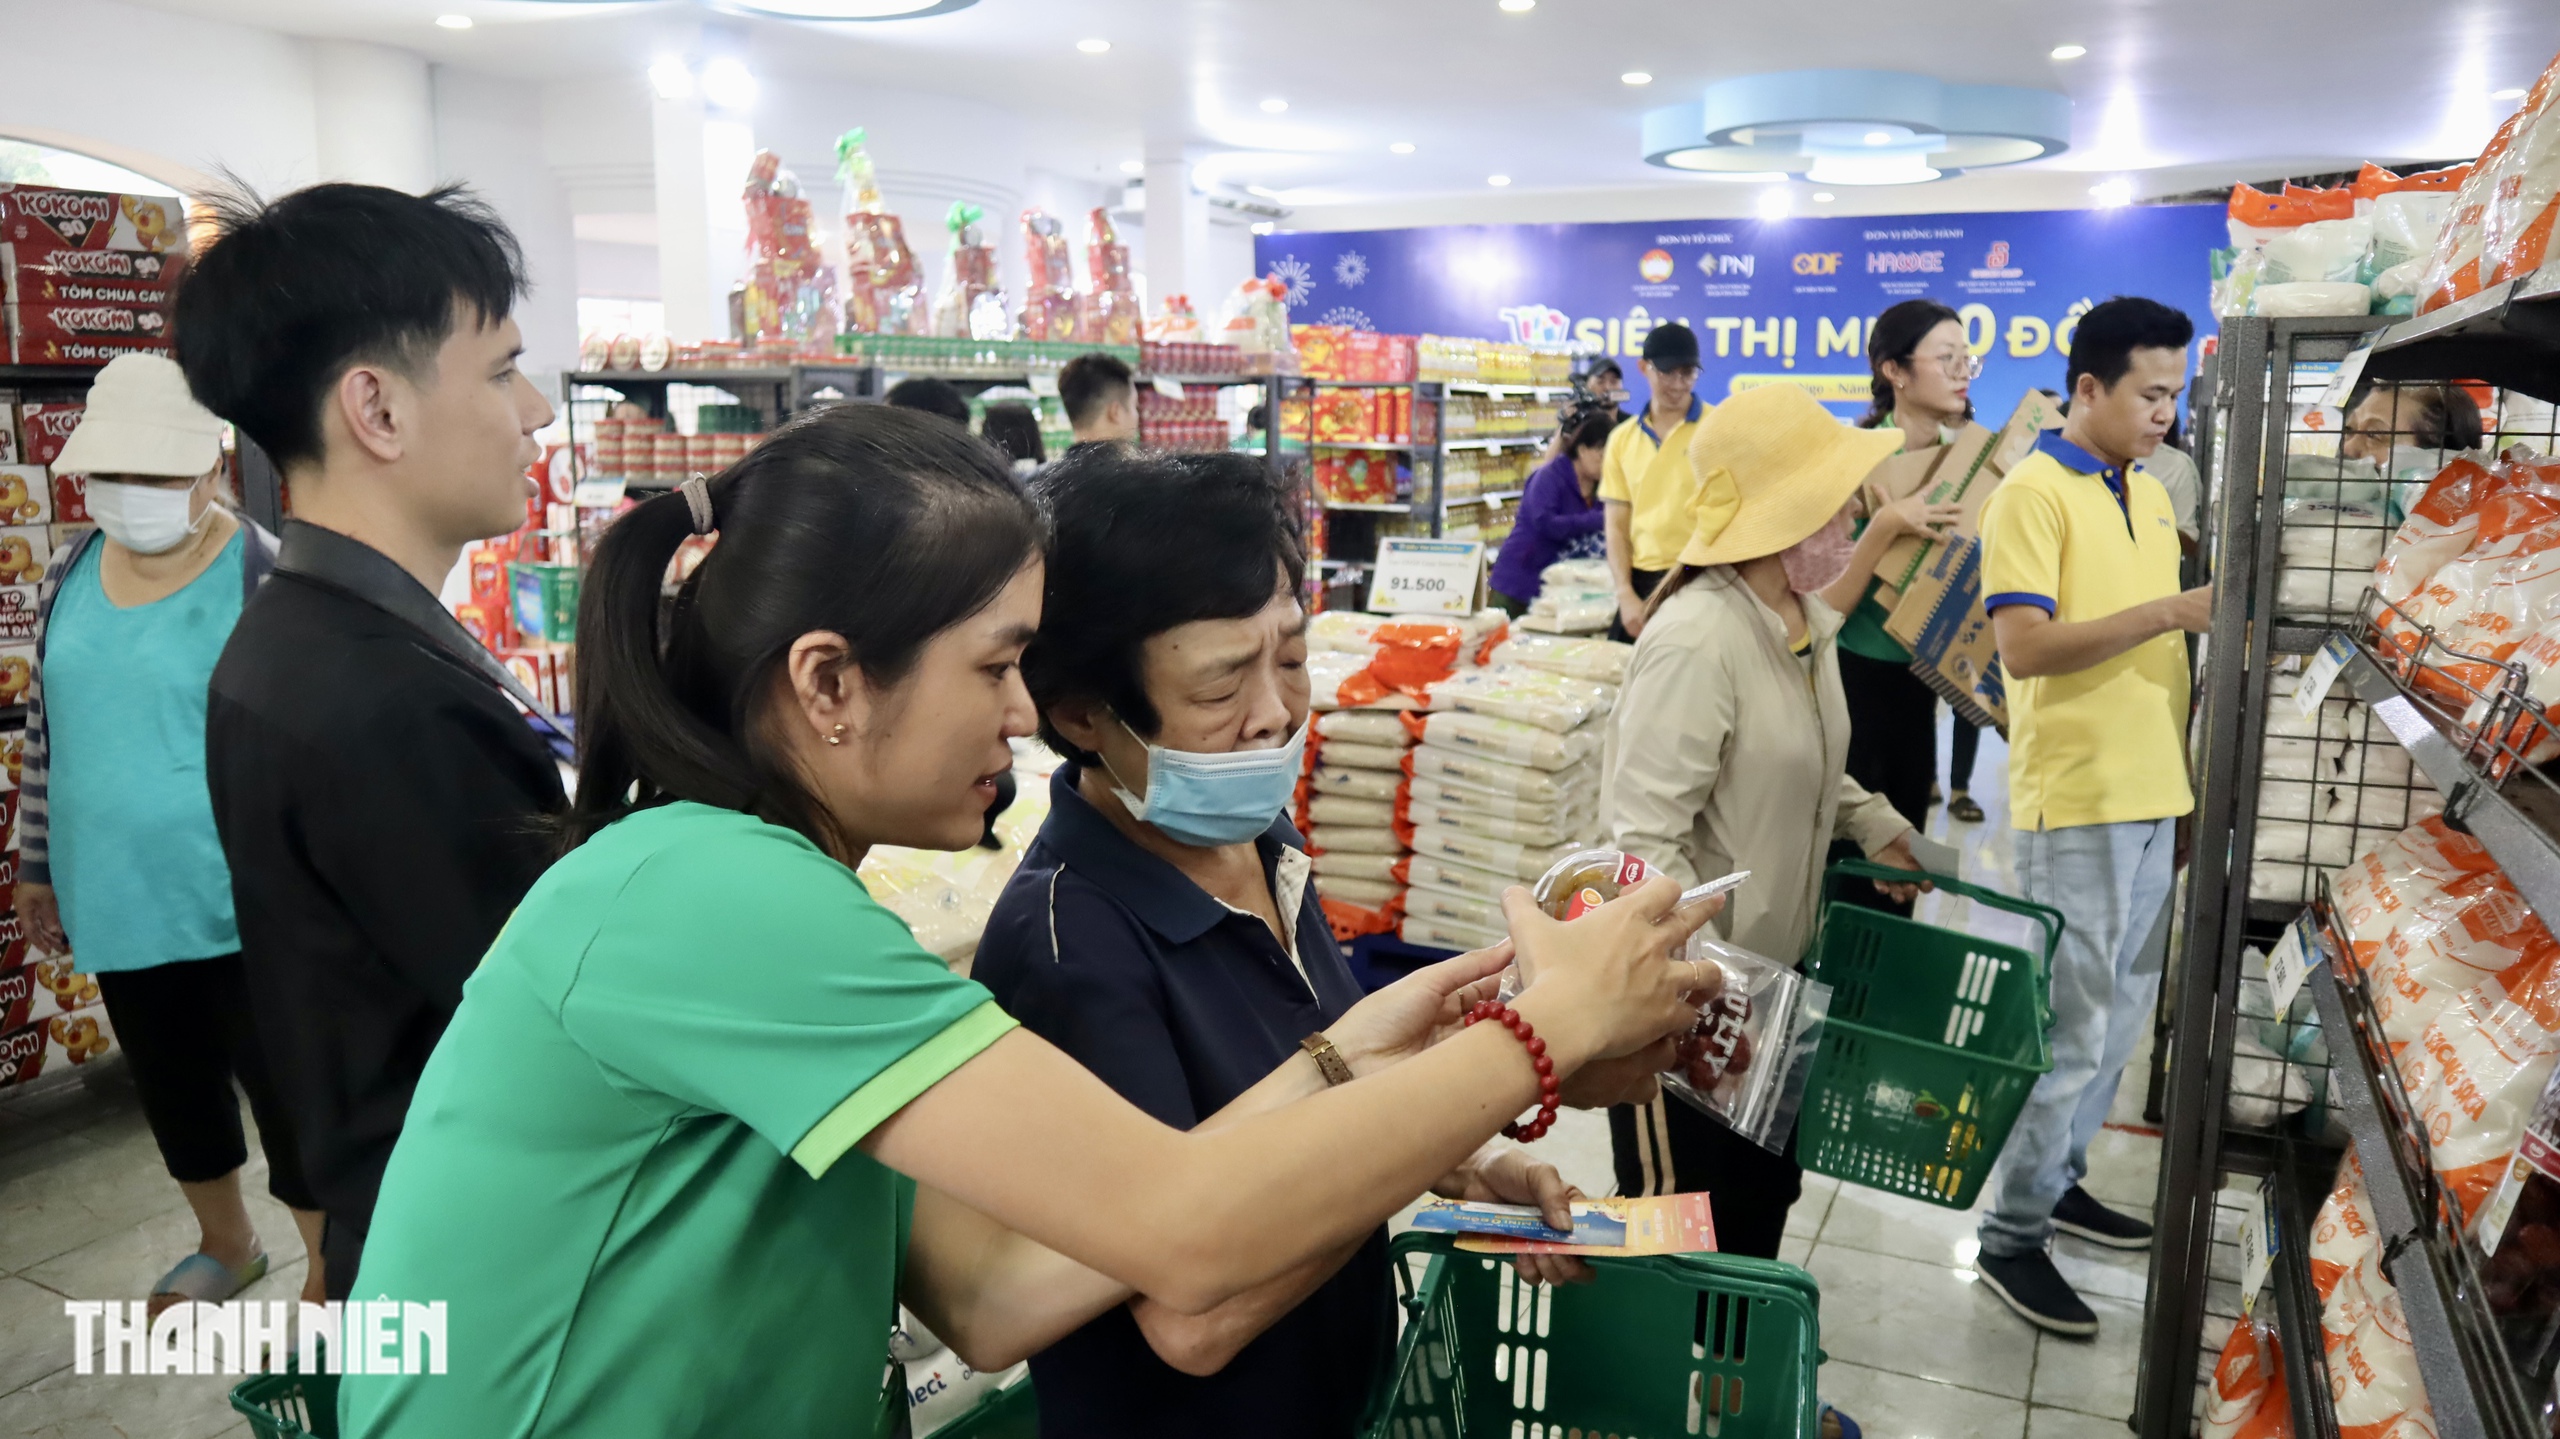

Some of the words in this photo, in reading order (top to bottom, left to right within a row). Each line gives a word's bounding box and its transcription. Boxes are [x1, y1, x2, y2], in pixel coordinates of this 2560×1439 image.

[17, 191, 110, 221] KOKOMI
[58, 219, 87, 238] 90
[51, 250, 131, 275] KOKOMI
[134, 256, 160, 275] 90
[1719, 254, 1755, 278] PNJ
[59, 282, 94, 300] TÔM
[96, 286, 137, 302] CHUA
[139, 288, 166, 302] CAY
[53, 308, 135, 333] KOKOMI
[137, 312, 164, 331] 90
[61, 341, 96, 359] TÔM
[1705, 316, 1798, 369] THỊ
[1390, 576, 1446, 592] 91.500
[1703, 974, 1749, 1080] NUTTY
